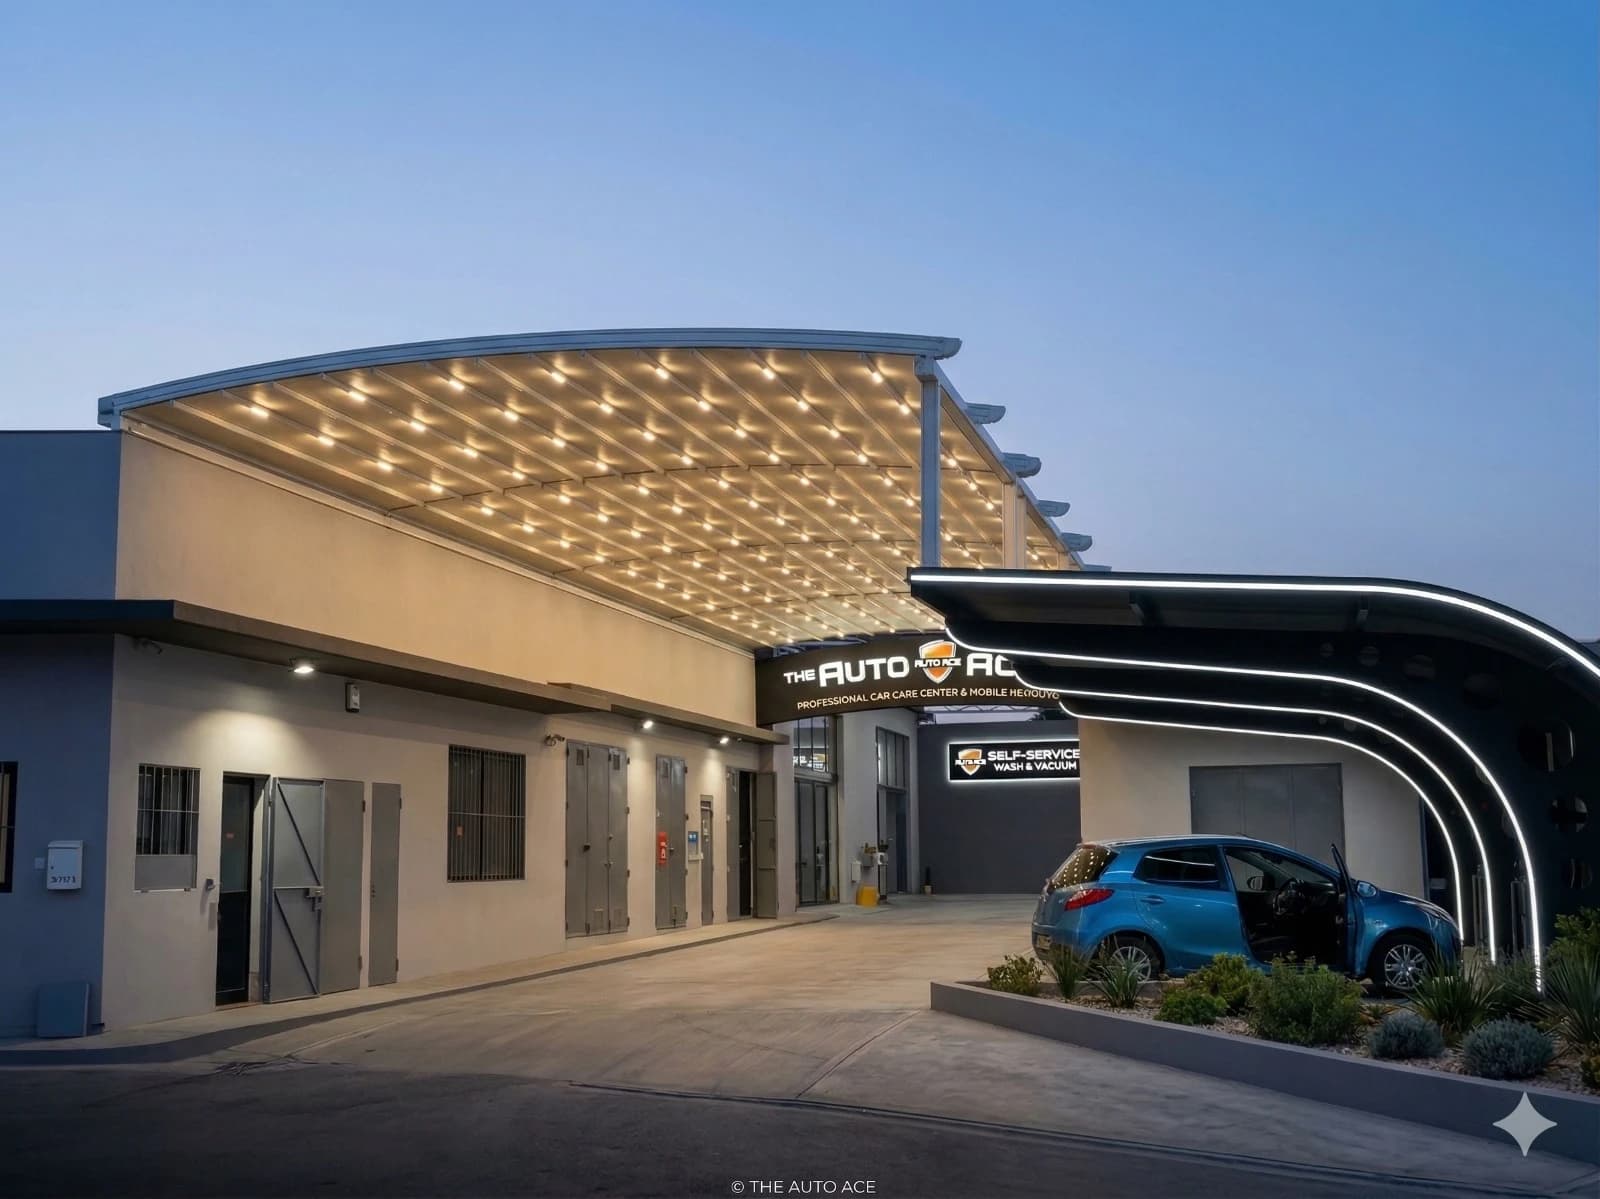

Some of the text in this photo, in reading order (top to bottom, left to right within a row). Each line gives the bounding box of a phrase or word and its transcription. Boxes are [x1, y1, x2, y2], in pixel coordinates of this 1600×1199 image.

[914, 659, 941, 668] AUTO
[784, 669, 816, 684] THE
[819, 656, 910, 687] AUTO
[797, 694, 869, 710] PROFESSIONAL
[870, 691, 890, 701] CAR
[892, 689, 918, 699] CARE
[920, 688, 958, 698] CENTER
[960, 687, 968, 697] &
[969, 688, 1008, 697] MOBILE
[987, 749, 1080, 761] SELF-SERVICE
[994, 761, 1077, 772] WASH & VACUUM
